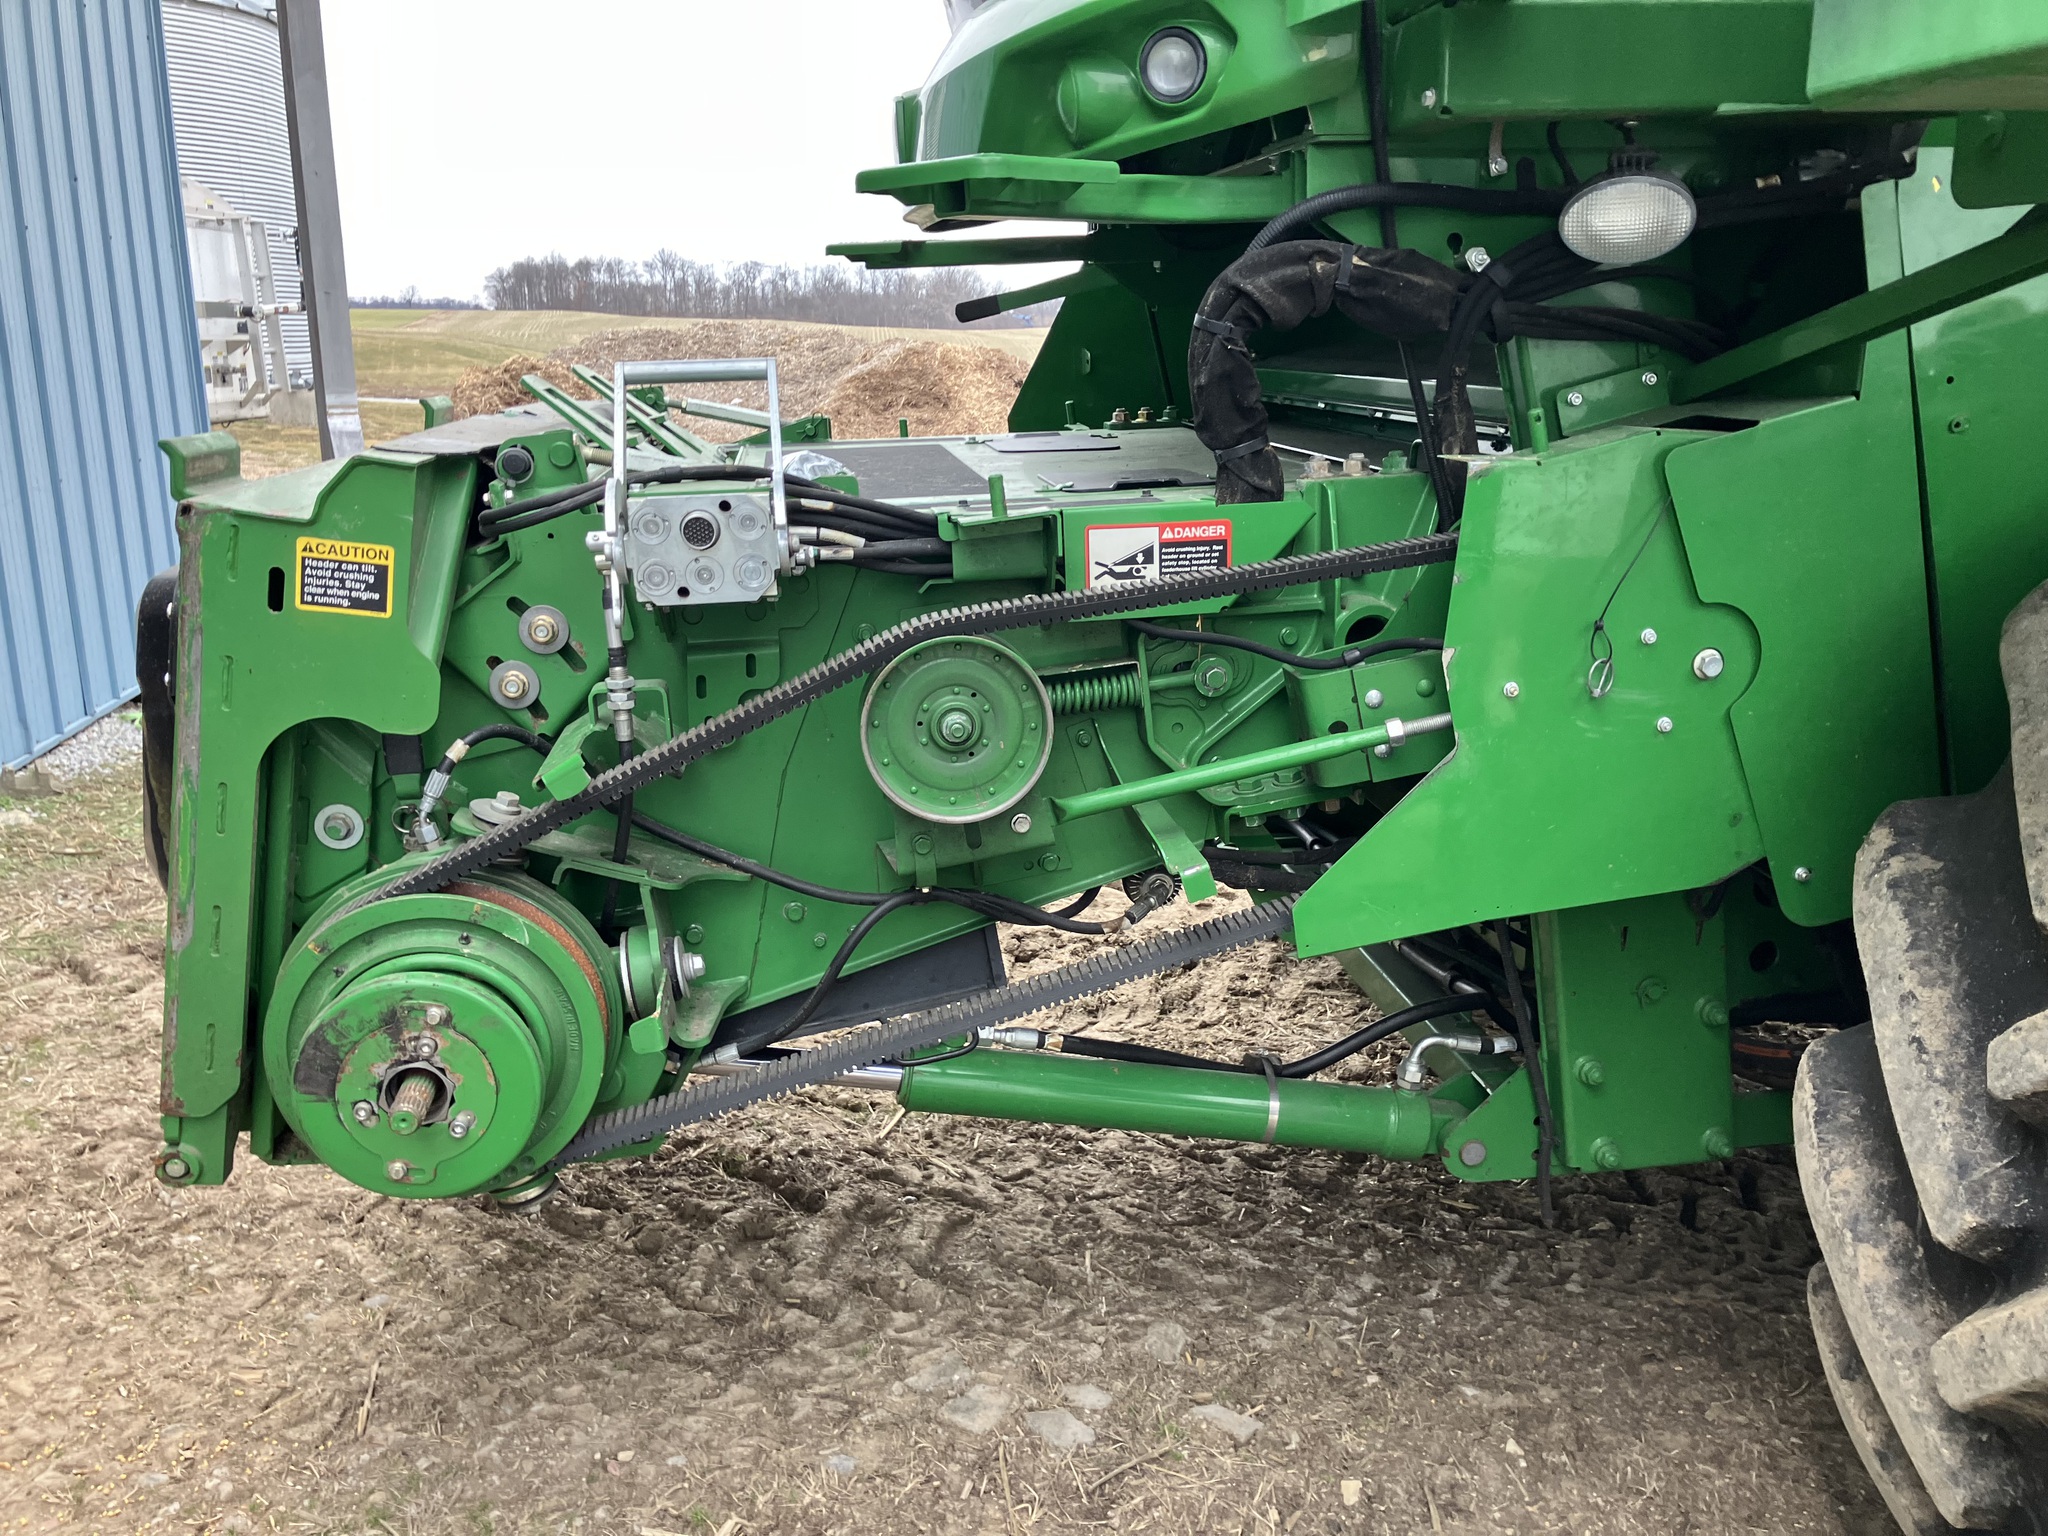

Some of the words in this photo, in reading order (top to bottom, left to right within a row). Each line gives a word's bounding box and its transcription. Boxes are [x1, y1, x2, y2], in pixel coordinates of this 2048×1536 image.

[1174, 526, 1225, 538] DANGER
[315, 543, 389, 561] CAUTION
[305, 558, 339, 569] Header
[342, 563, 359, 571] can
[305, 567, 331, 577] Avoid
[334, 571, 375, 583] crushing
[345, 579, 366, 591] Stay
[304, 585, 325, 594] clear
[327, 587, 349, 596] when
[351, 590, 380, 600] engine
[304, 594, 312, 602] is
[314, 596, 351, 607] running.
[568, 1024, 580, 1052] MADE
